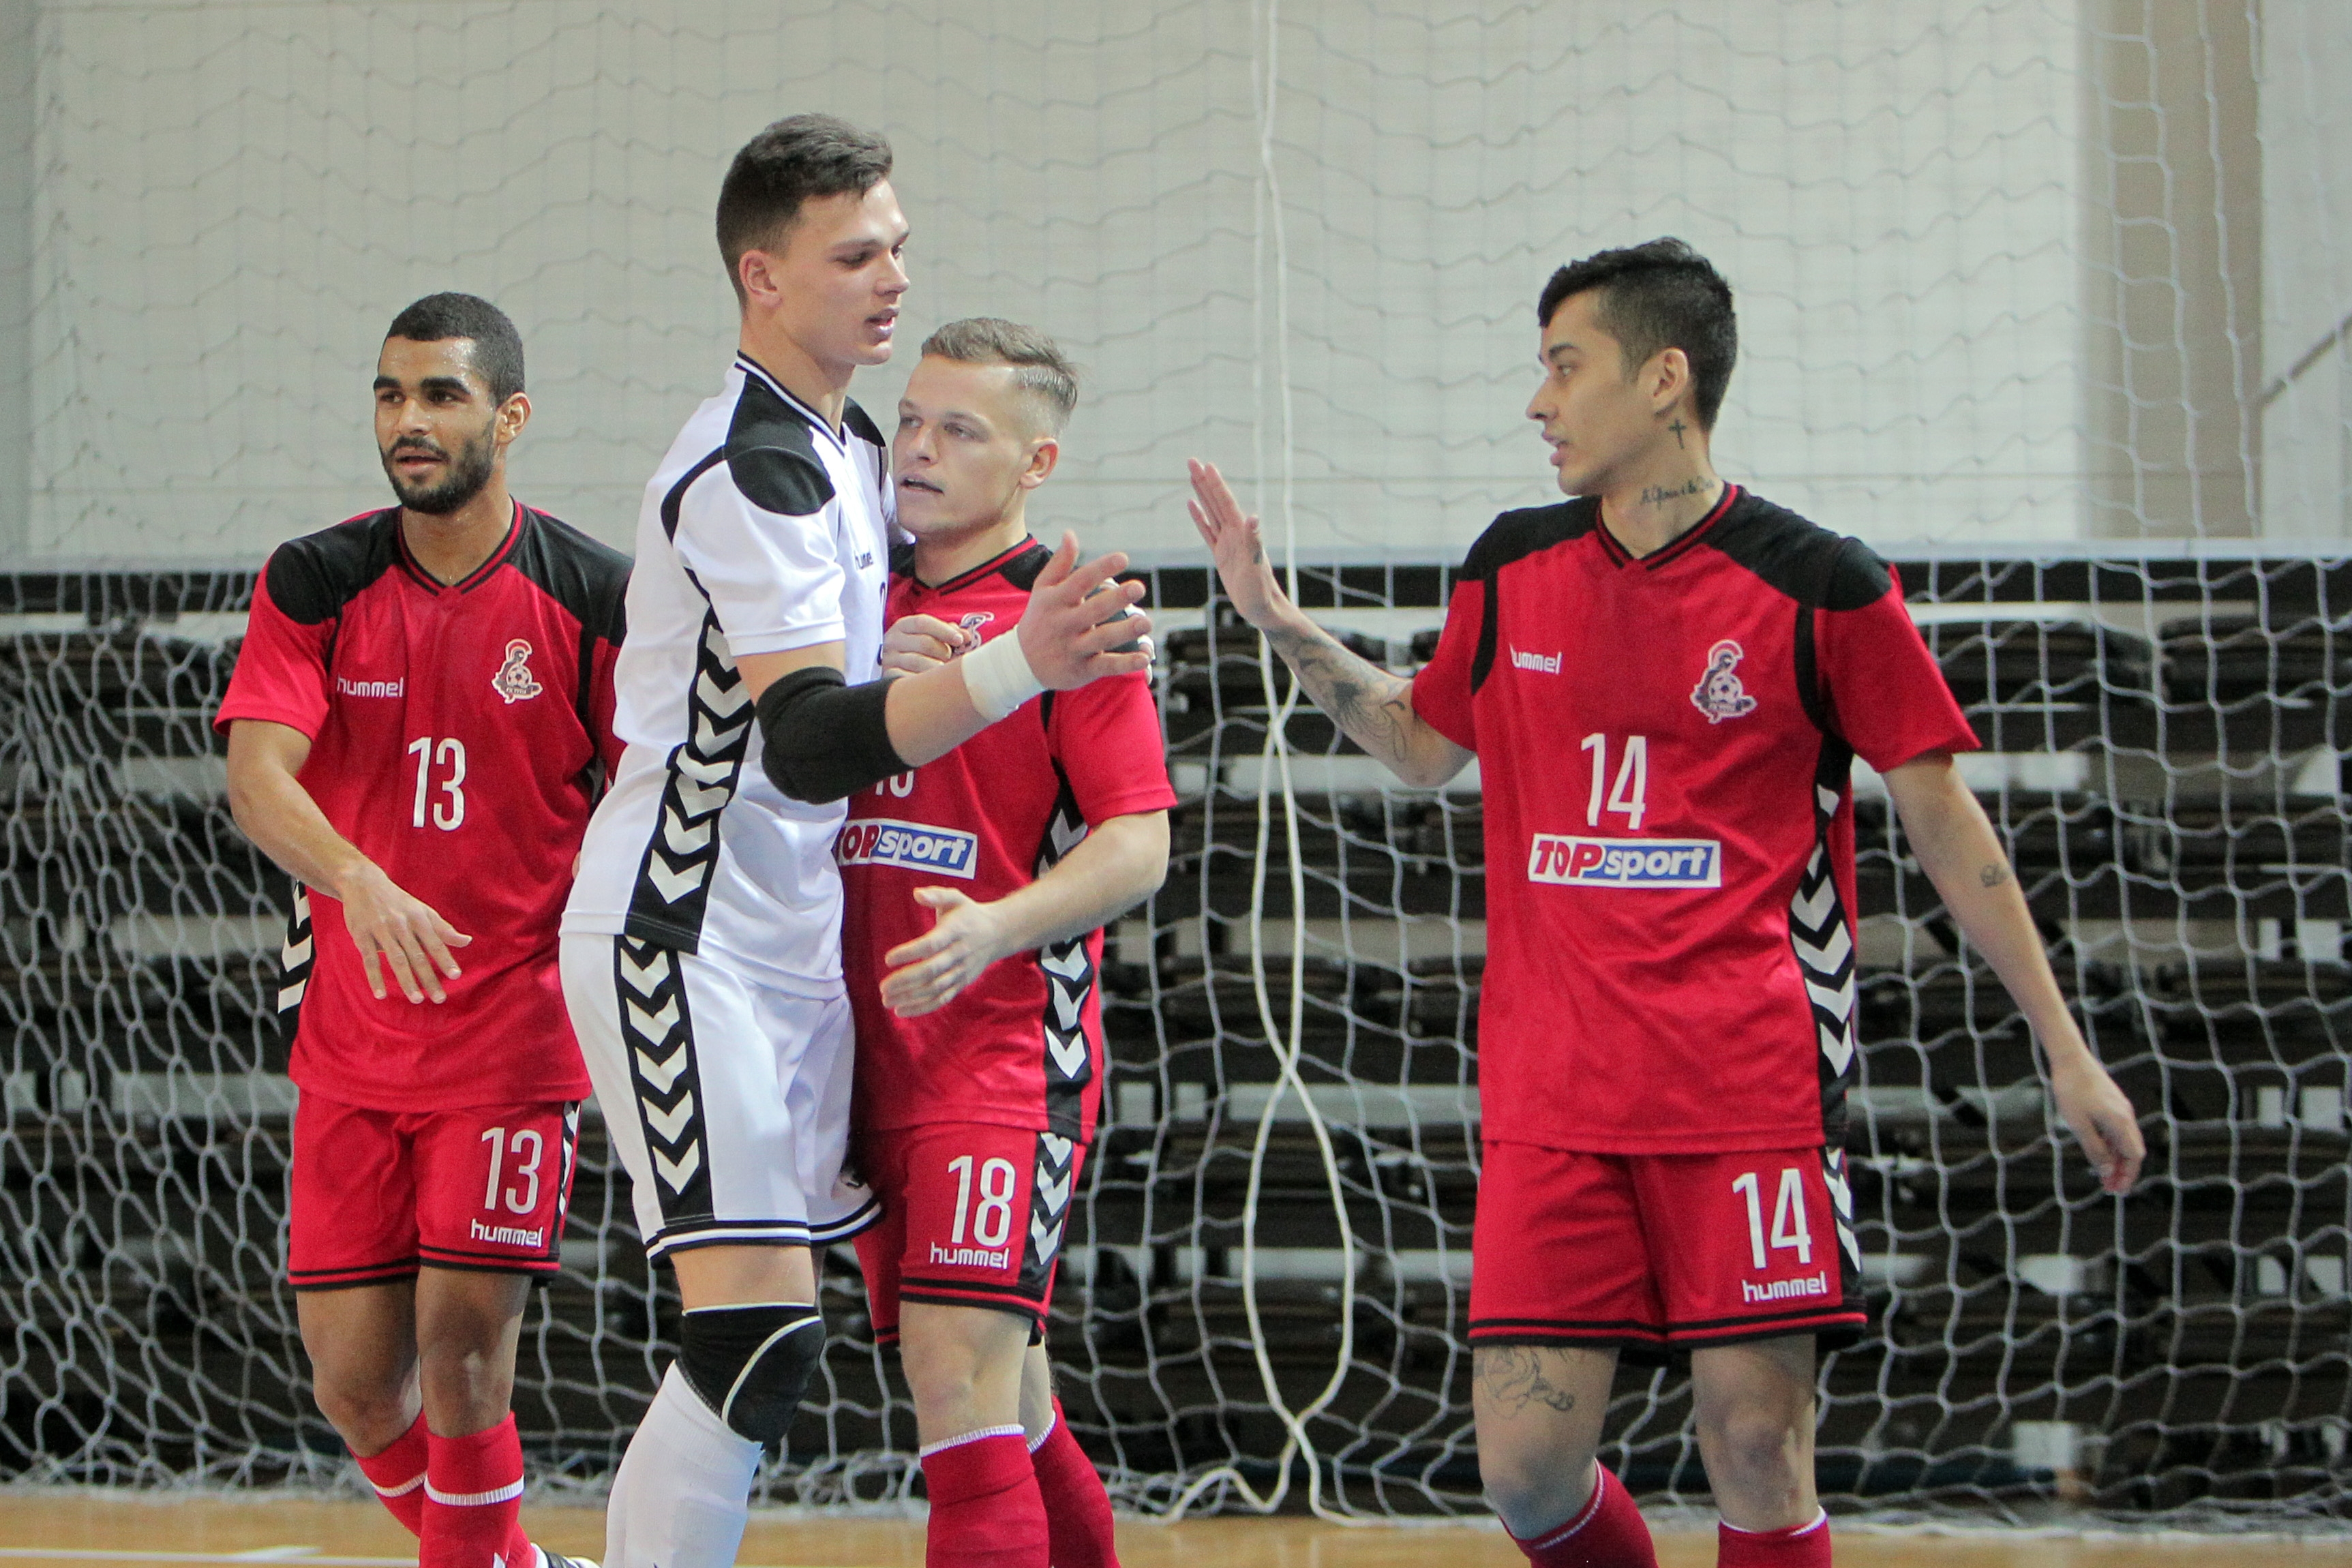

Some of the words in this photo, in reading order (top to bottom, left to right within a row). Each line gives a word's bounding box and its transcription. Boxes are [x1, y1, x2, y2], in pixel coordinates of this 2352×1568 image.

[336, 674, 404, 697] hummel
[408, 737, 466, 831] 13
[1581, 733, 1647, 830] 14
[836, 824, 967, 864] OPsport
[1535, 839, 1705, 879] TOPsport
[481, 1127, 543, 1214] 13
[948, 1155, 1016, 1247] 18
[1732, 1168, 1811, 1269] 14
[470, 1218, 543, 1248] hummel
[930, 1241, 1010, 1269] hummel
[1742, 1270, 1827, 1303] hummel
